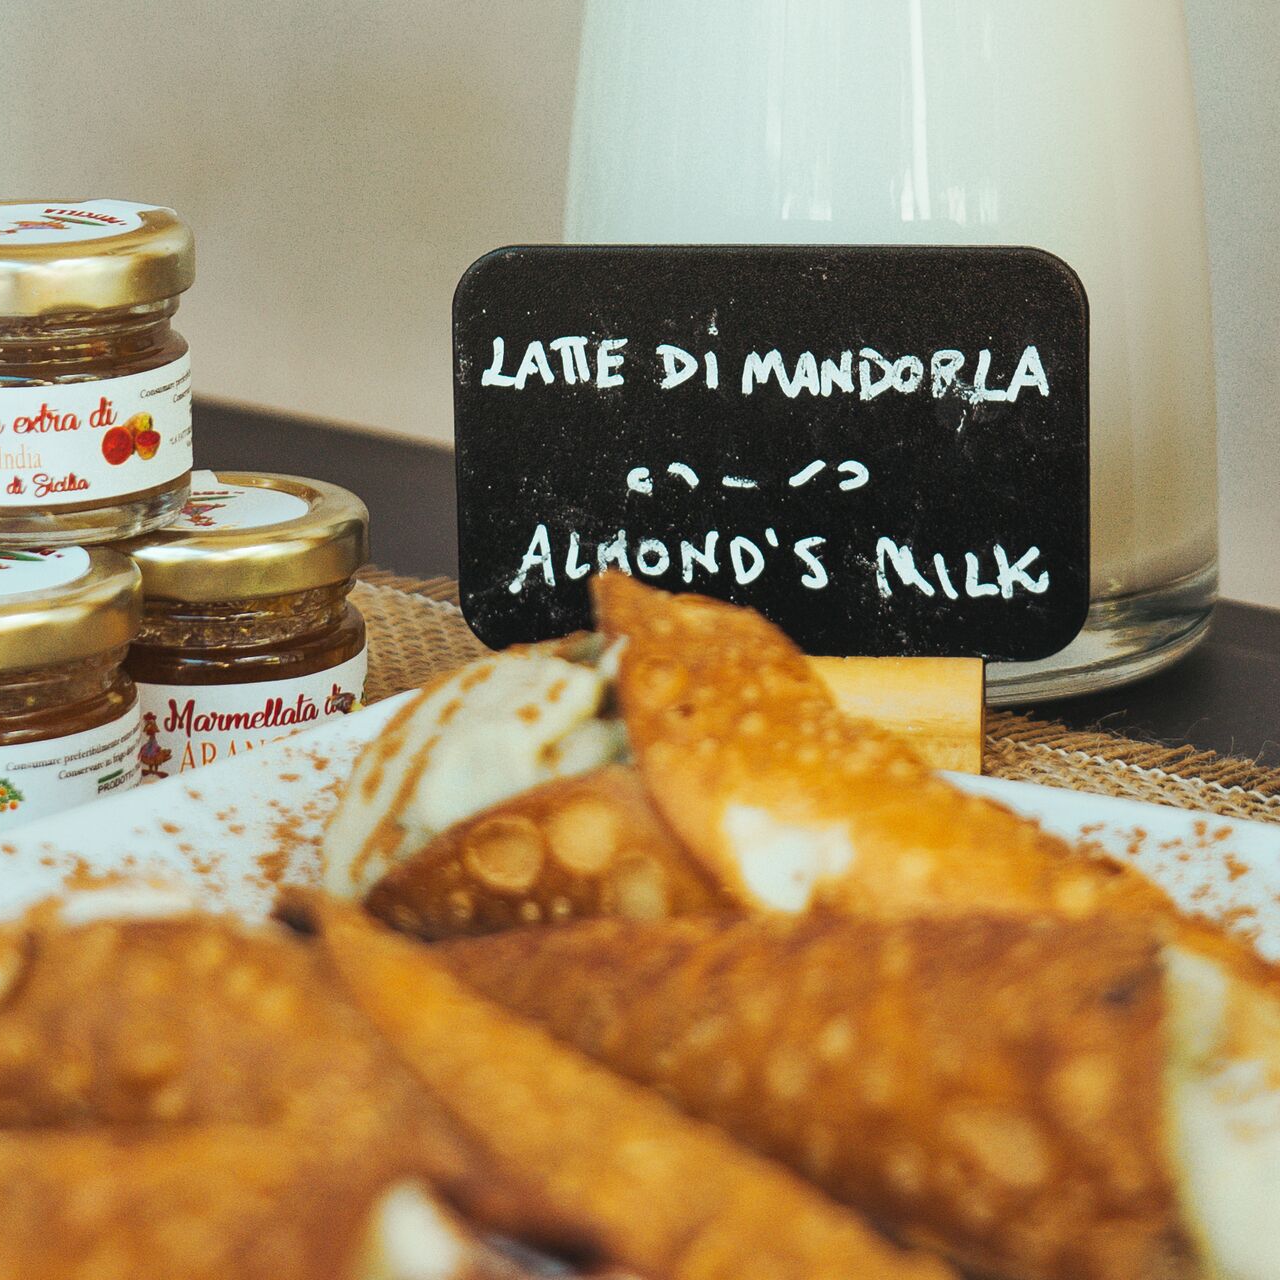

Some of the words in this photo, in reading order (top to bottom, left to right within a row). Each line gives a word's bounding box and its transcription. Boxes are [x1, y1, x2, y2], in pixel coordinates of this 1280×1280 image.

[481, 335, 628, 390] LATTE
[741, 344, 1050, 404] MANDORLA
[13, 403, 81, 434] extra
[90, 397, 118, 429] di
[6, 475, 27, 495] di
[32, 473, 90, 497] Sicilia
[508, 523, 829, 592] ALMOND'S
[875, 536, 1050, 599] MILK
[163, 693, 320, 737] Marmellata
